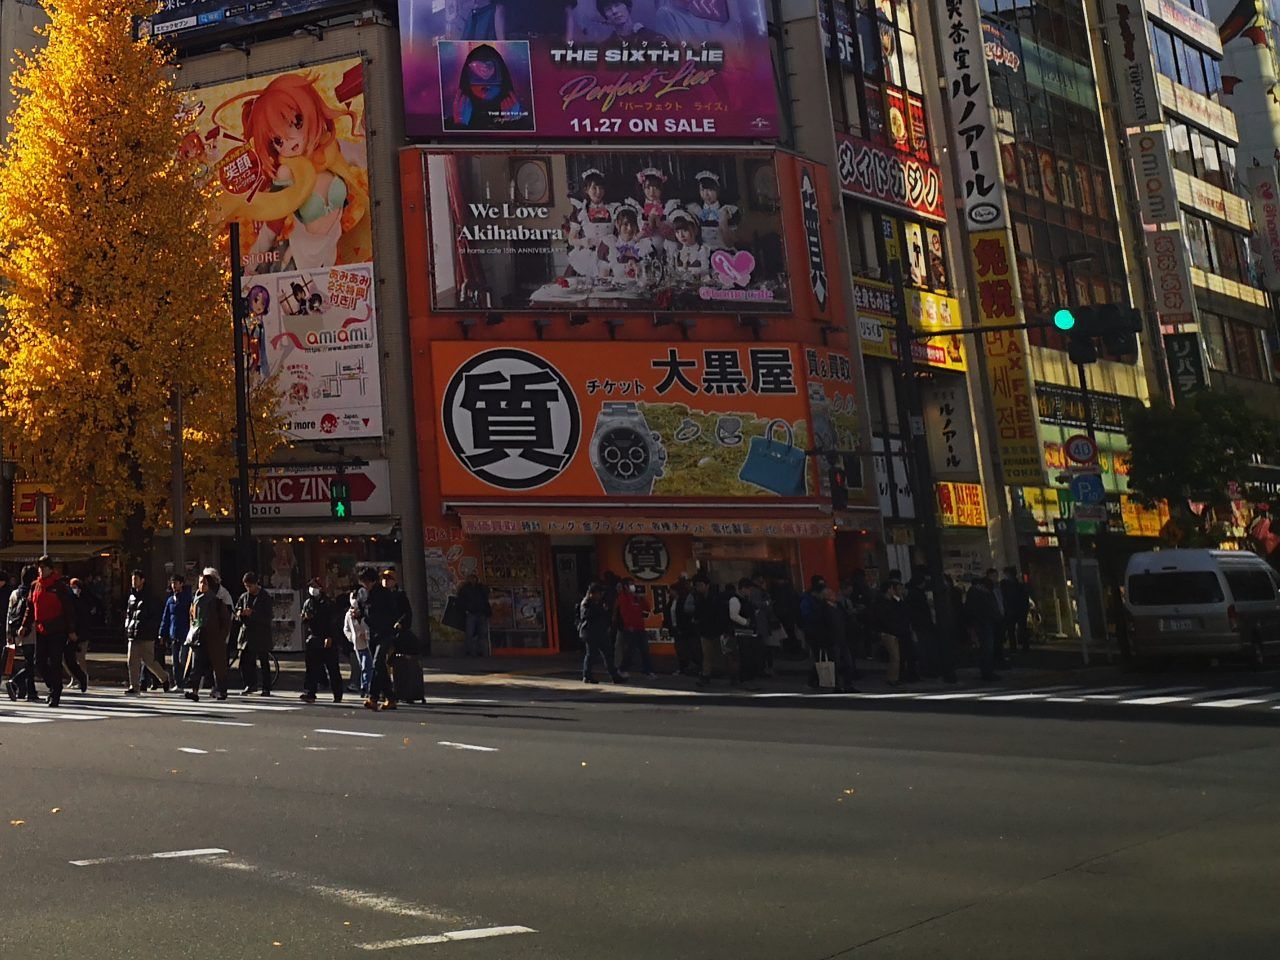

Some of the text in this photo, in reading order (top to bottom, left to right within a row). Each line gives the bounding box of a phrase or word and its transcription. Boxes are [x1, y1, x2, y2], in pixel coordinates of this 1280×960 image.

[550, 49, 723, 62] THE SIXTH LIE
[559, 59, 718, 113] Perfect Lies
[570, 119, 716, 133] 11.27 ON SALE
[223, 152, 253, 181] 笑顔
[839, 141, 940, 212] メイドカジノ
[469, 203, 549, 219] We Love
[458, 224, 563, 241] Akihabara
[242, 251, 280, 265] STORE
[306, 327, 368, 346] amiami
[651, 348, 798, 395] 大黒屋
[586, 379, 646, 396] チケット
[294, 420, 316, 431] more
[460, 370, 569, 471] 質
